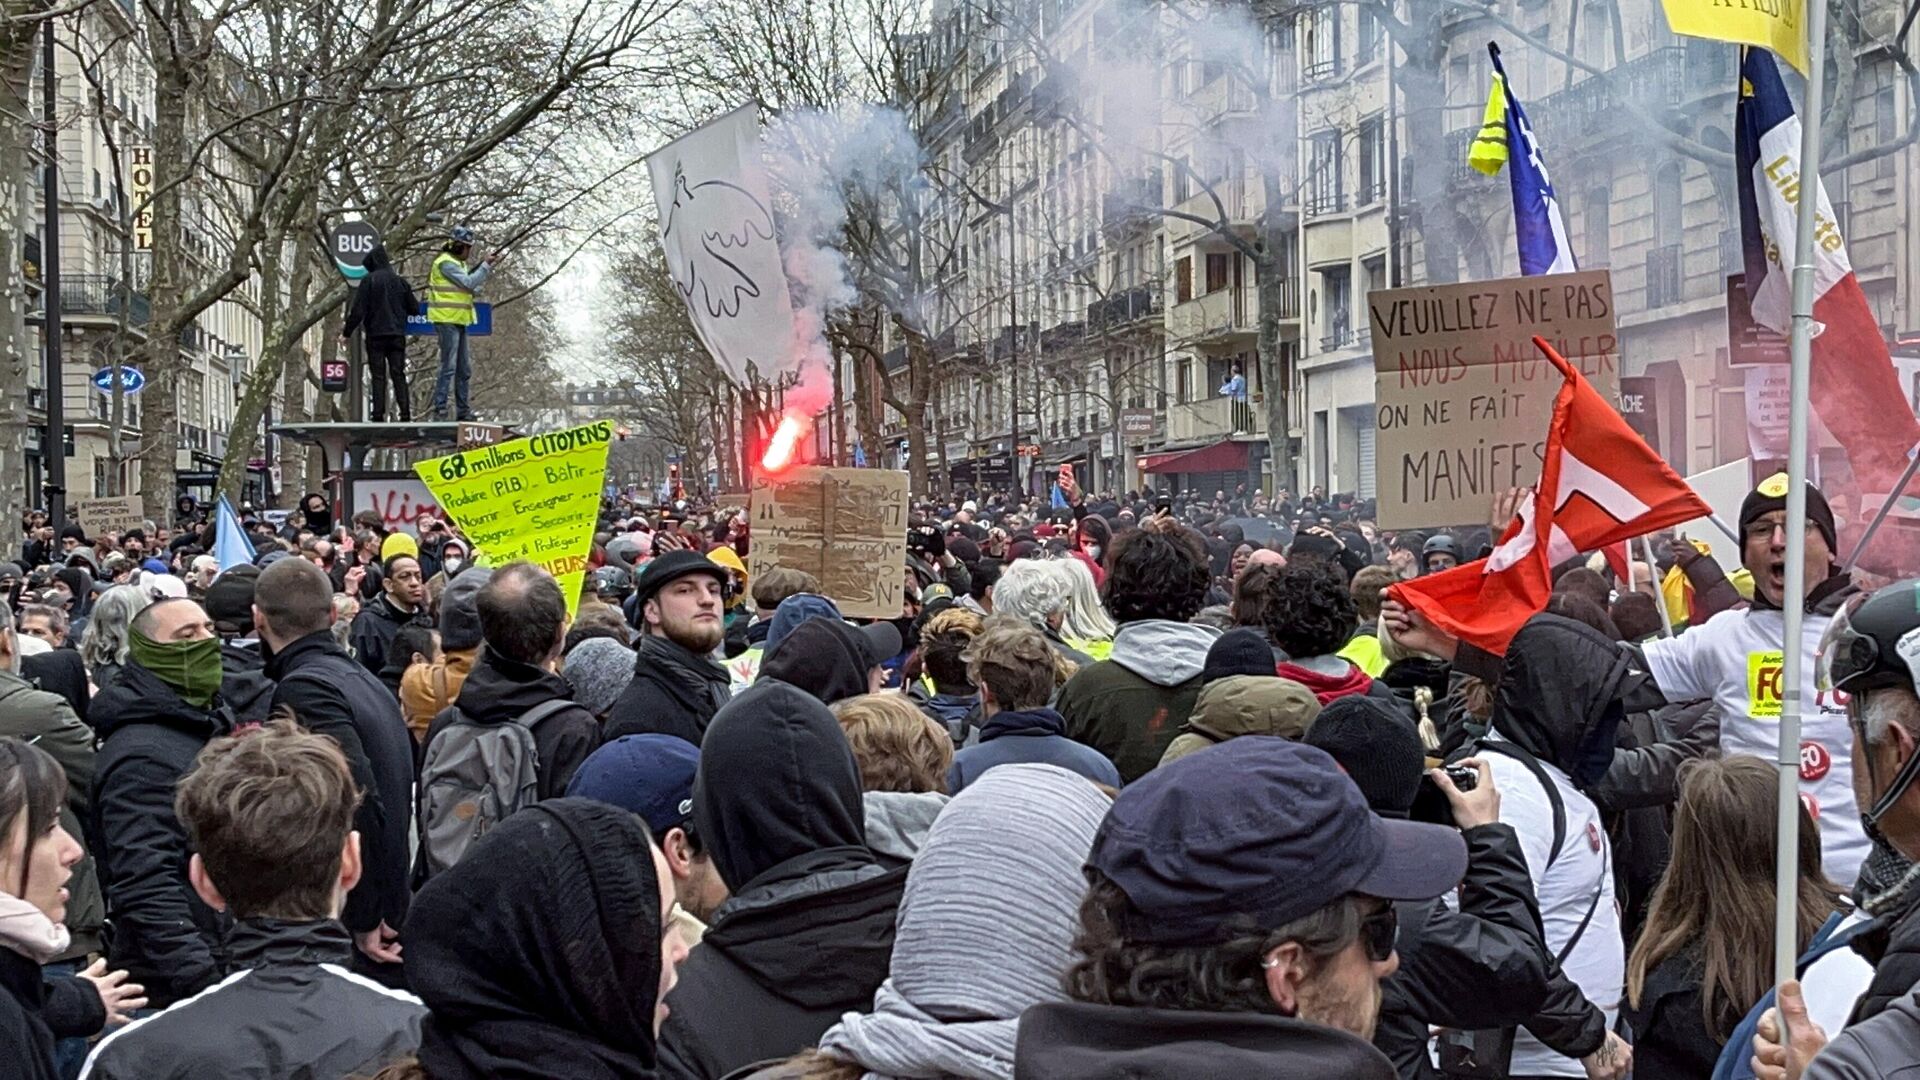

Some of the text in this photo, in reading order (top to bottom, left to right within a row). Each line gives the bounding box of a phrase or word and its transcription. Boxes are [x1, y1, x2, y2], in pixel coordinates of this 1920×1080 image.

[133, 147, 152, 250] HOTEL
[338, 234, 373, 253] BUS
[1515, 288, 1552, 325] NE
[1565, 283, 1608, 320] PAS
[326, 364, 344, 377] 56
[1399, 346, 1468, 389] NOUS
[1379, 404, 1408, 430] ON
[1423, 400, 1451, 427] NE
[464, 426, 493, 442] JUL
[439, 452, 468, 481] 68
[470, 446, 526, 473] millions
[442, 488, 488, 510] Produire
[544, 461, 586, 485] Bâtir
[456, 493, 574, 531] Nourrir Enseigner
[470, 512, 584, 547] Soigner Secourir
[1800, 745, 1820, 773] FO
